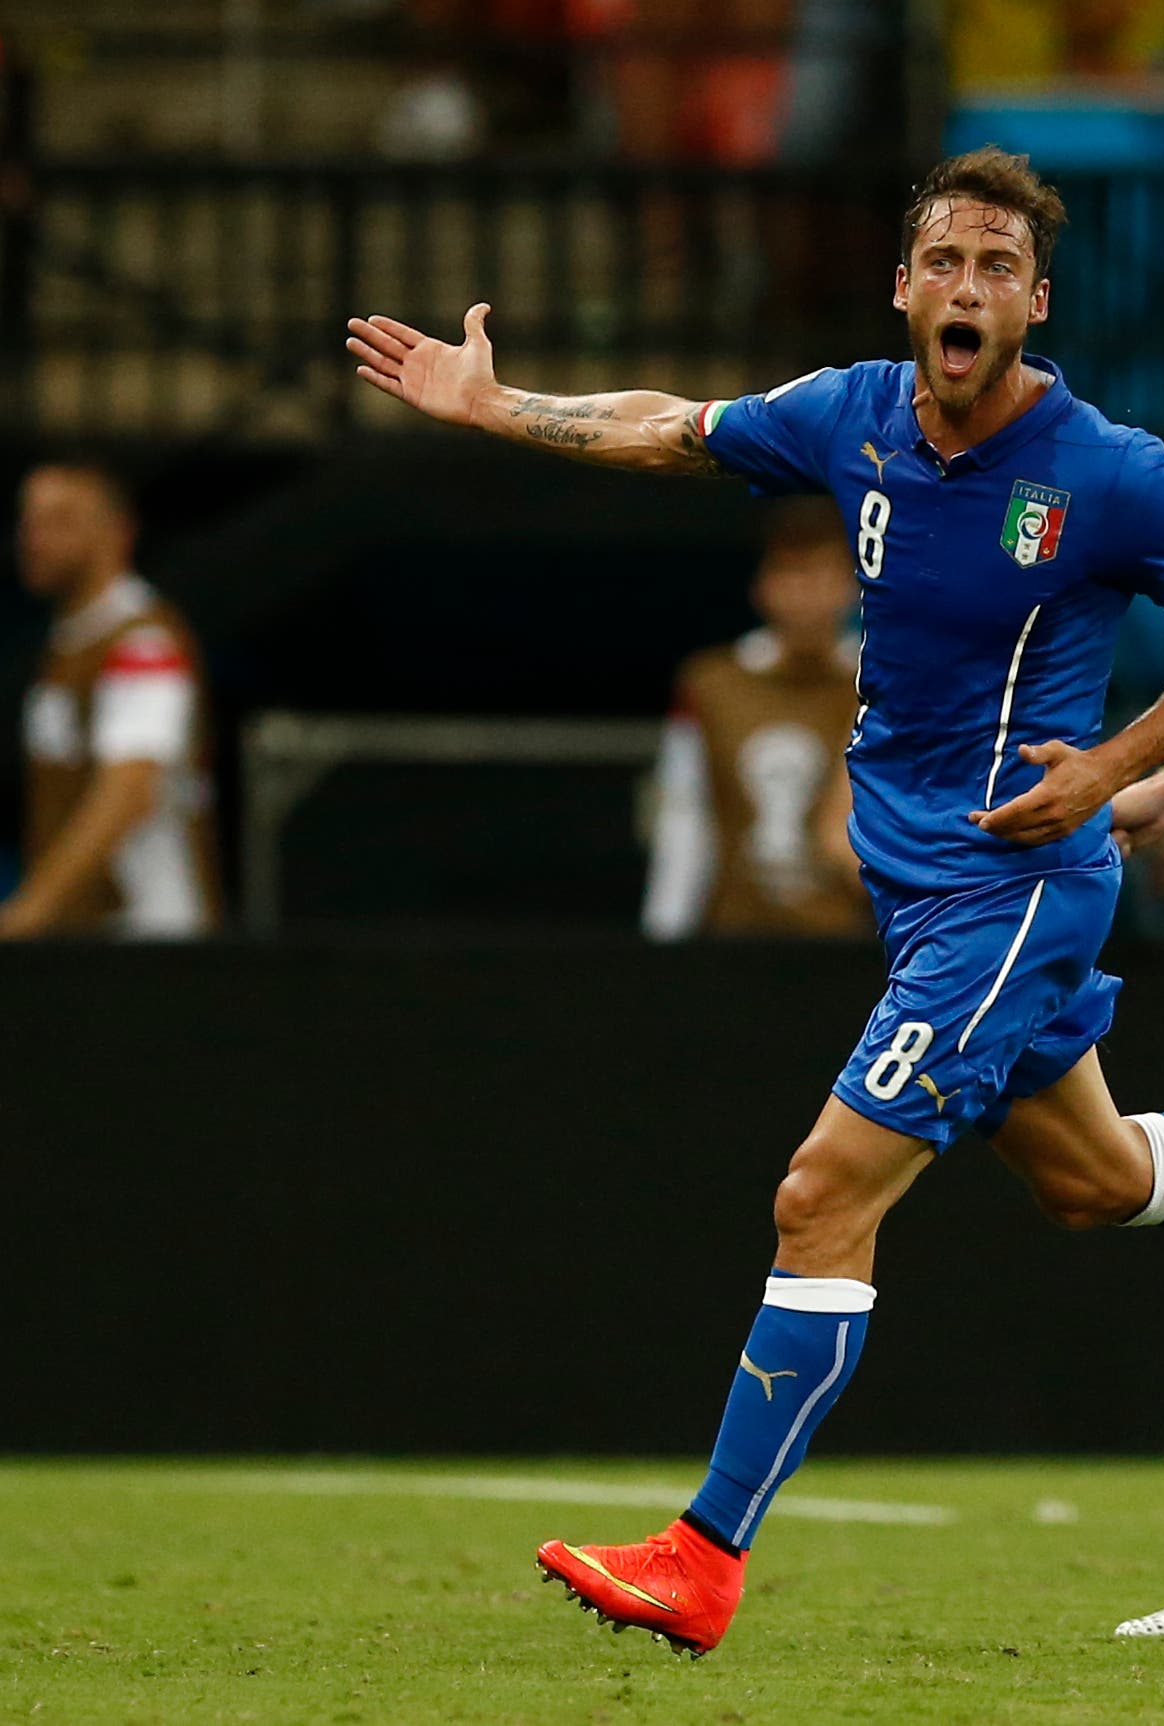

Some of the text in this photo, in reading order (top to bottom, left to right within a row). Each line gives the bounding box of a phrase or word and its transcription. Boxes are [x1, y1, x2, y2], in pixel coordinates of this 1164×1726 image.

[858, 490, 892, 579] 8
[1018, 486, 1061, 505] ITALIA
[864, 1021, 935, 1101] 8
